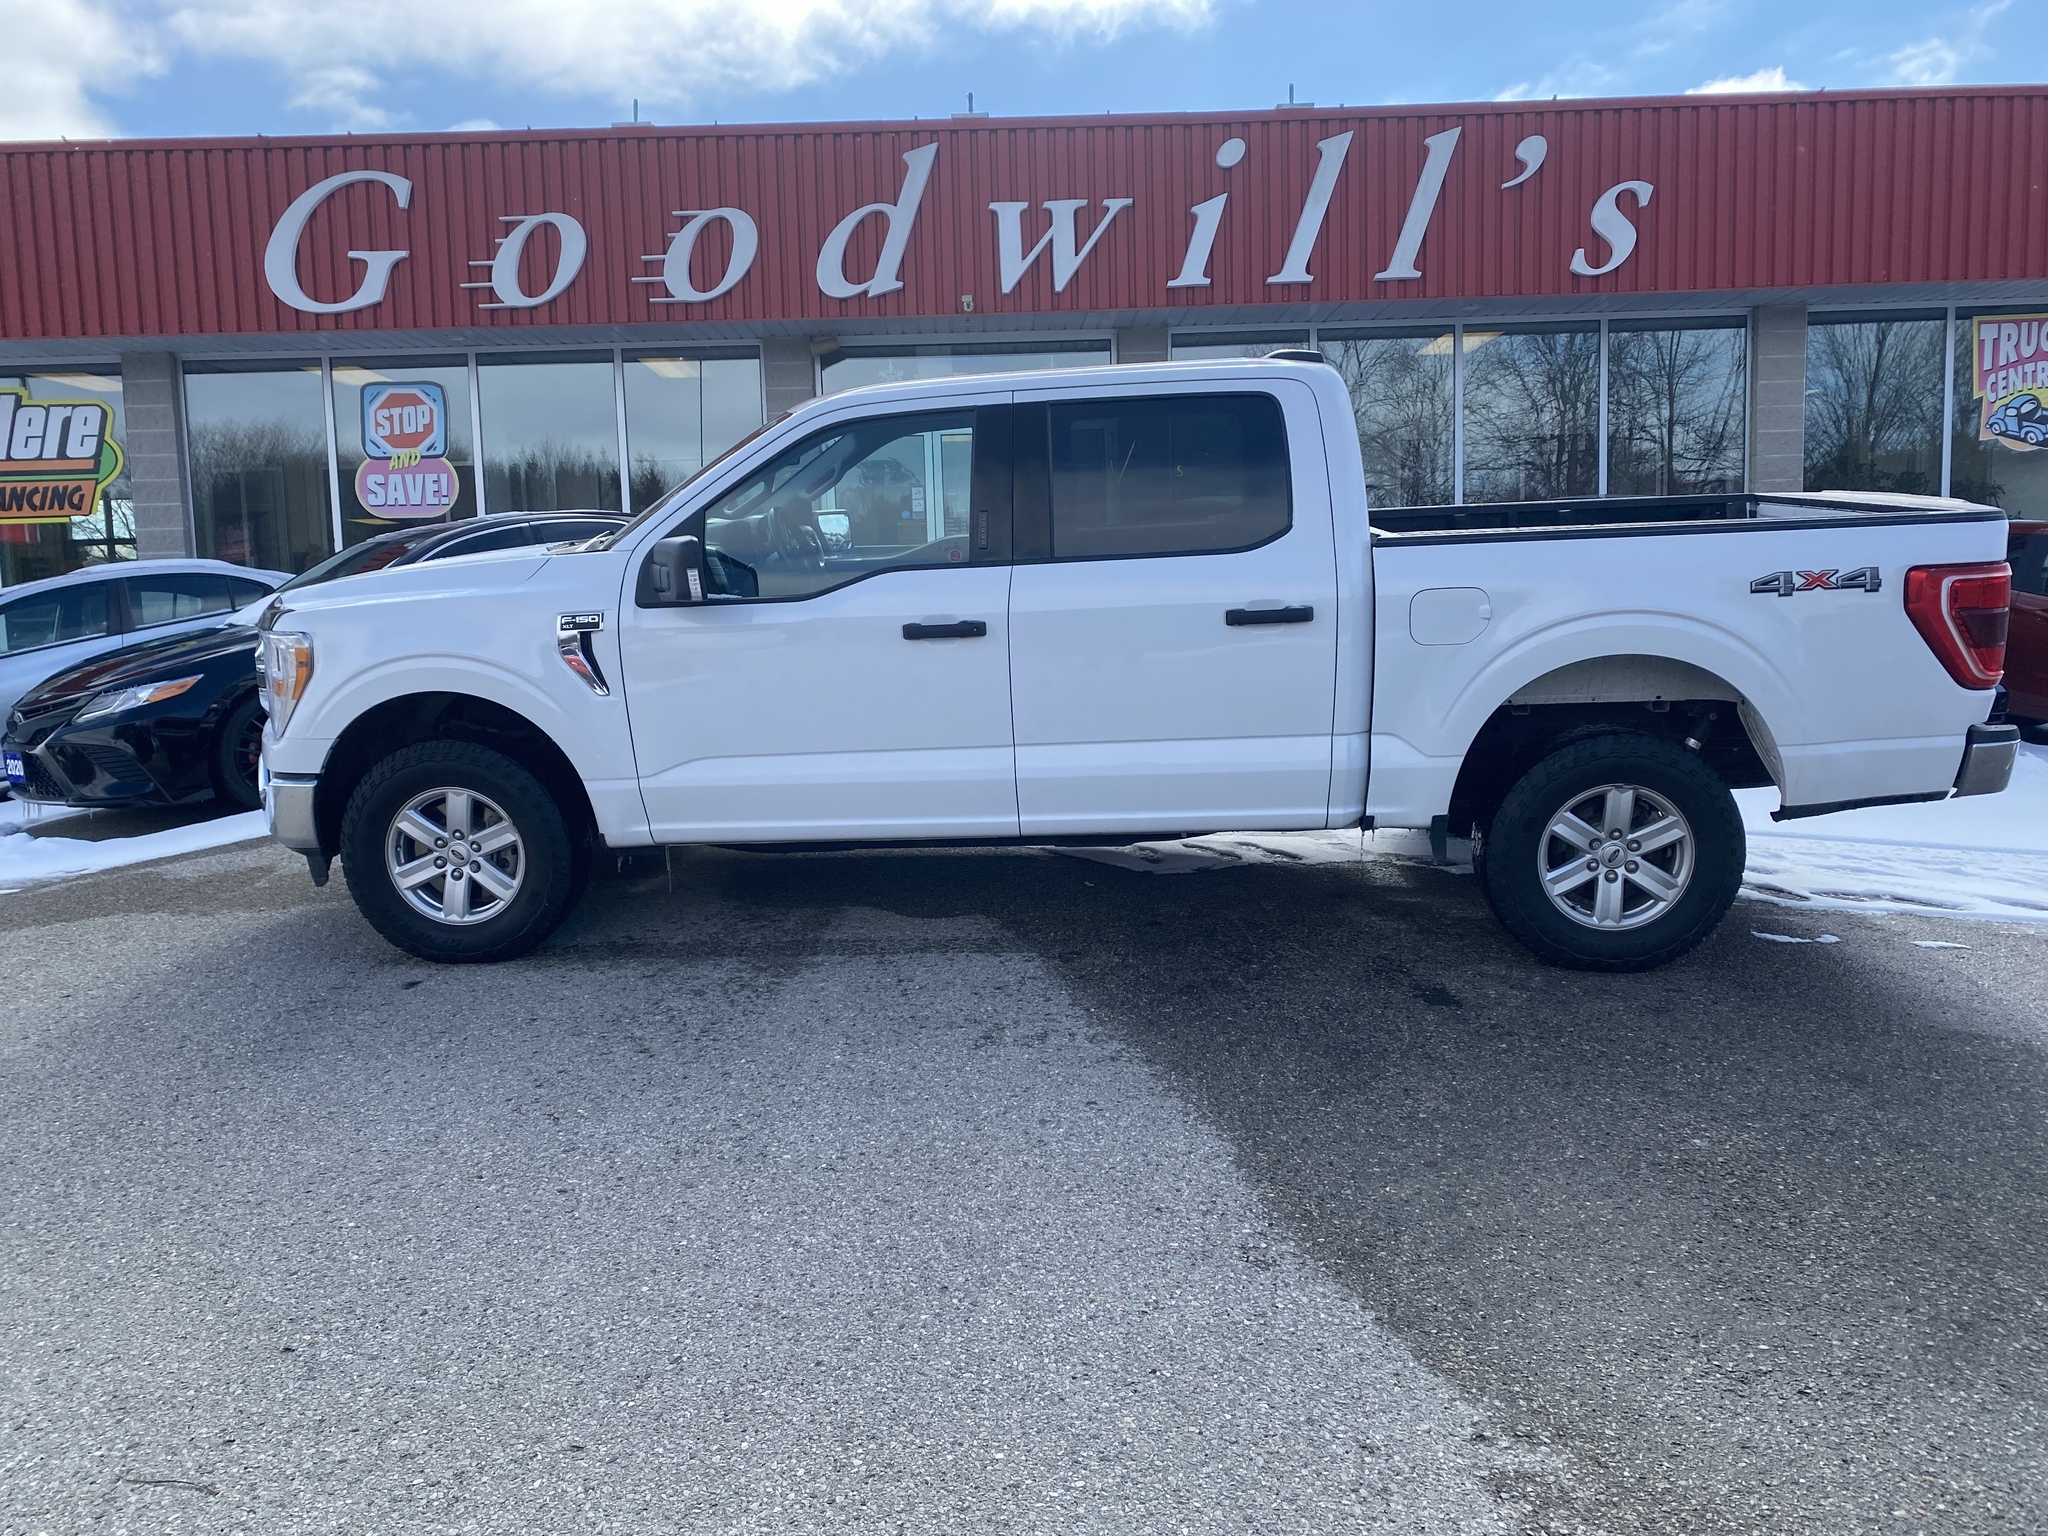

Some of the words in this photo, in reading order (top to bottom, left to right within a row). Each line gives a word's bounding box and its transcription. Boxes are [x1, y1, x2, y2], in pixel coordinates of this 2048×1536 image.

[264, 126, 1655, 315] Goodwill's
[376, 404, 431, 437] STOP
[389, 449, 421, 471] AND
[366, 473, 450, 507] SAVE!
[561, 615, 599, 624] F-150
[6, 759, 24, 776] 2020
